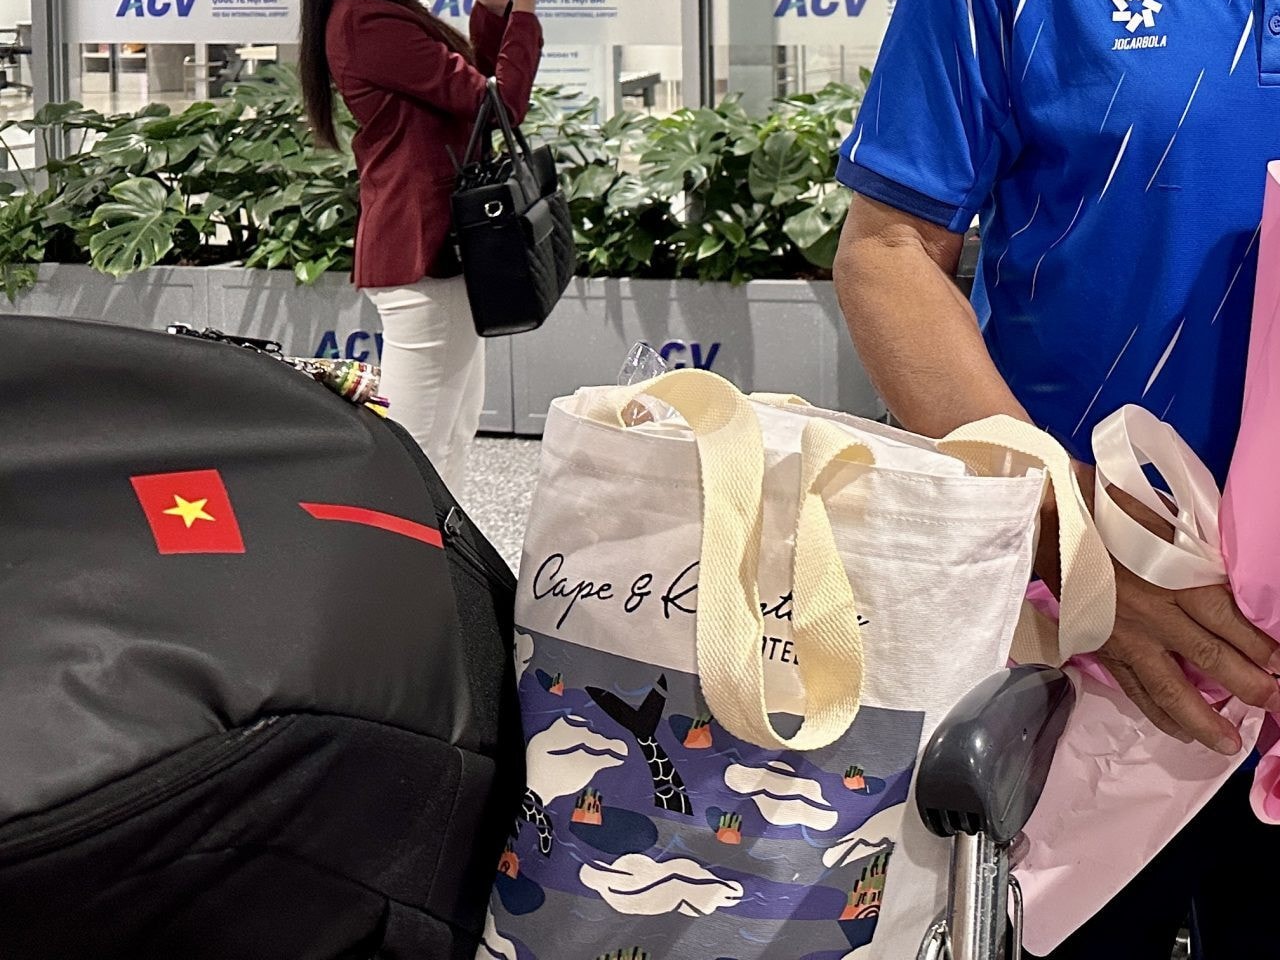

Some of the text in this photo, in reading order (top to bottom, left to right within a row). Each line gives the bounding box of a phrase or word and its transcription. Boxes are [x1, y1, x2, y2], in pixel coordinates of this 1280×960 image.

[1111, 35, 1168, 51] JOGARBOLA
[532, 552, 614, 630] Cape
[623, 573, 653, 614] &
